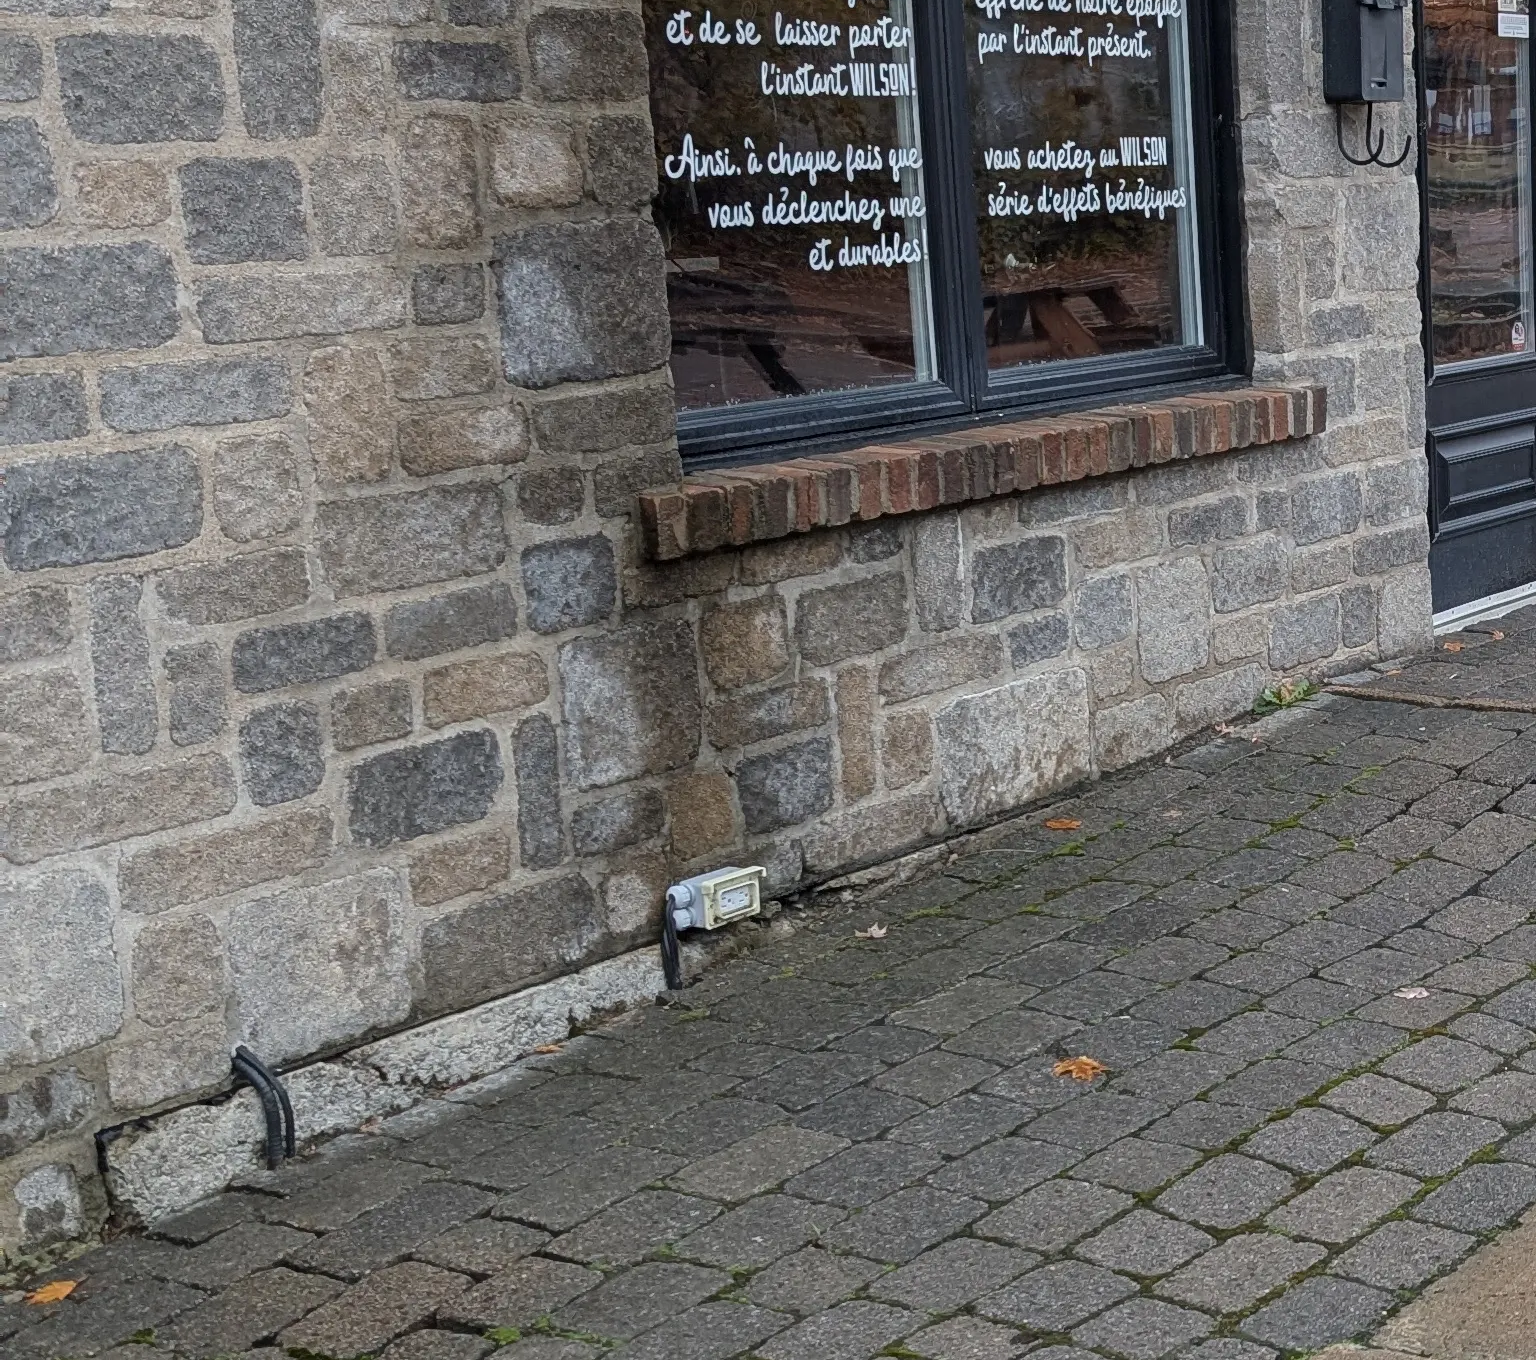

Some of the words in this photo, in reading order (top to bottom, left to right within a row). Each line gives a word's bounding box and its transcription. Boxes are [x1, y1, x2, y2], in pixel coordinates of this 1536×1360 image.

[666, 9, 694, 46] et
[699, 10, 731, 45] de
[735, 18, 762, 46] se
[775, 11, 841, 47] laisser
[849, 16, 912, 59] porter
[978, 30, 1008, 65] par
[1013, 23, 1085, 57] l'instant
[1088, 22, 1152, 67] présent.
[761, 60, 849, 97] l'instant
[849, 57, 918, 98] WILSON!
[767, 142, 843, 186] chaque
[846, 144, 883, 182] fois
[888, 145, 923, 182] que
[984, 146, 1022, 170] vous
[1027, 140, 1096, 179] achetez
[1100, 147, 1120, 167] au
[1119, 136, 1168, 167] WILSON
[708, 200, 755, 229] vous
[762, 186, 886, 231] déclenchez
[889, 195, 927, 219] une
[987, 181, 1034, 217] série
[1037, 183, 1101, 222] d'effets
[1105, 178, 1187, 220] bénéfiques
[809, 237, 834, 271] et
[838, 228, 930, 269] durables!
